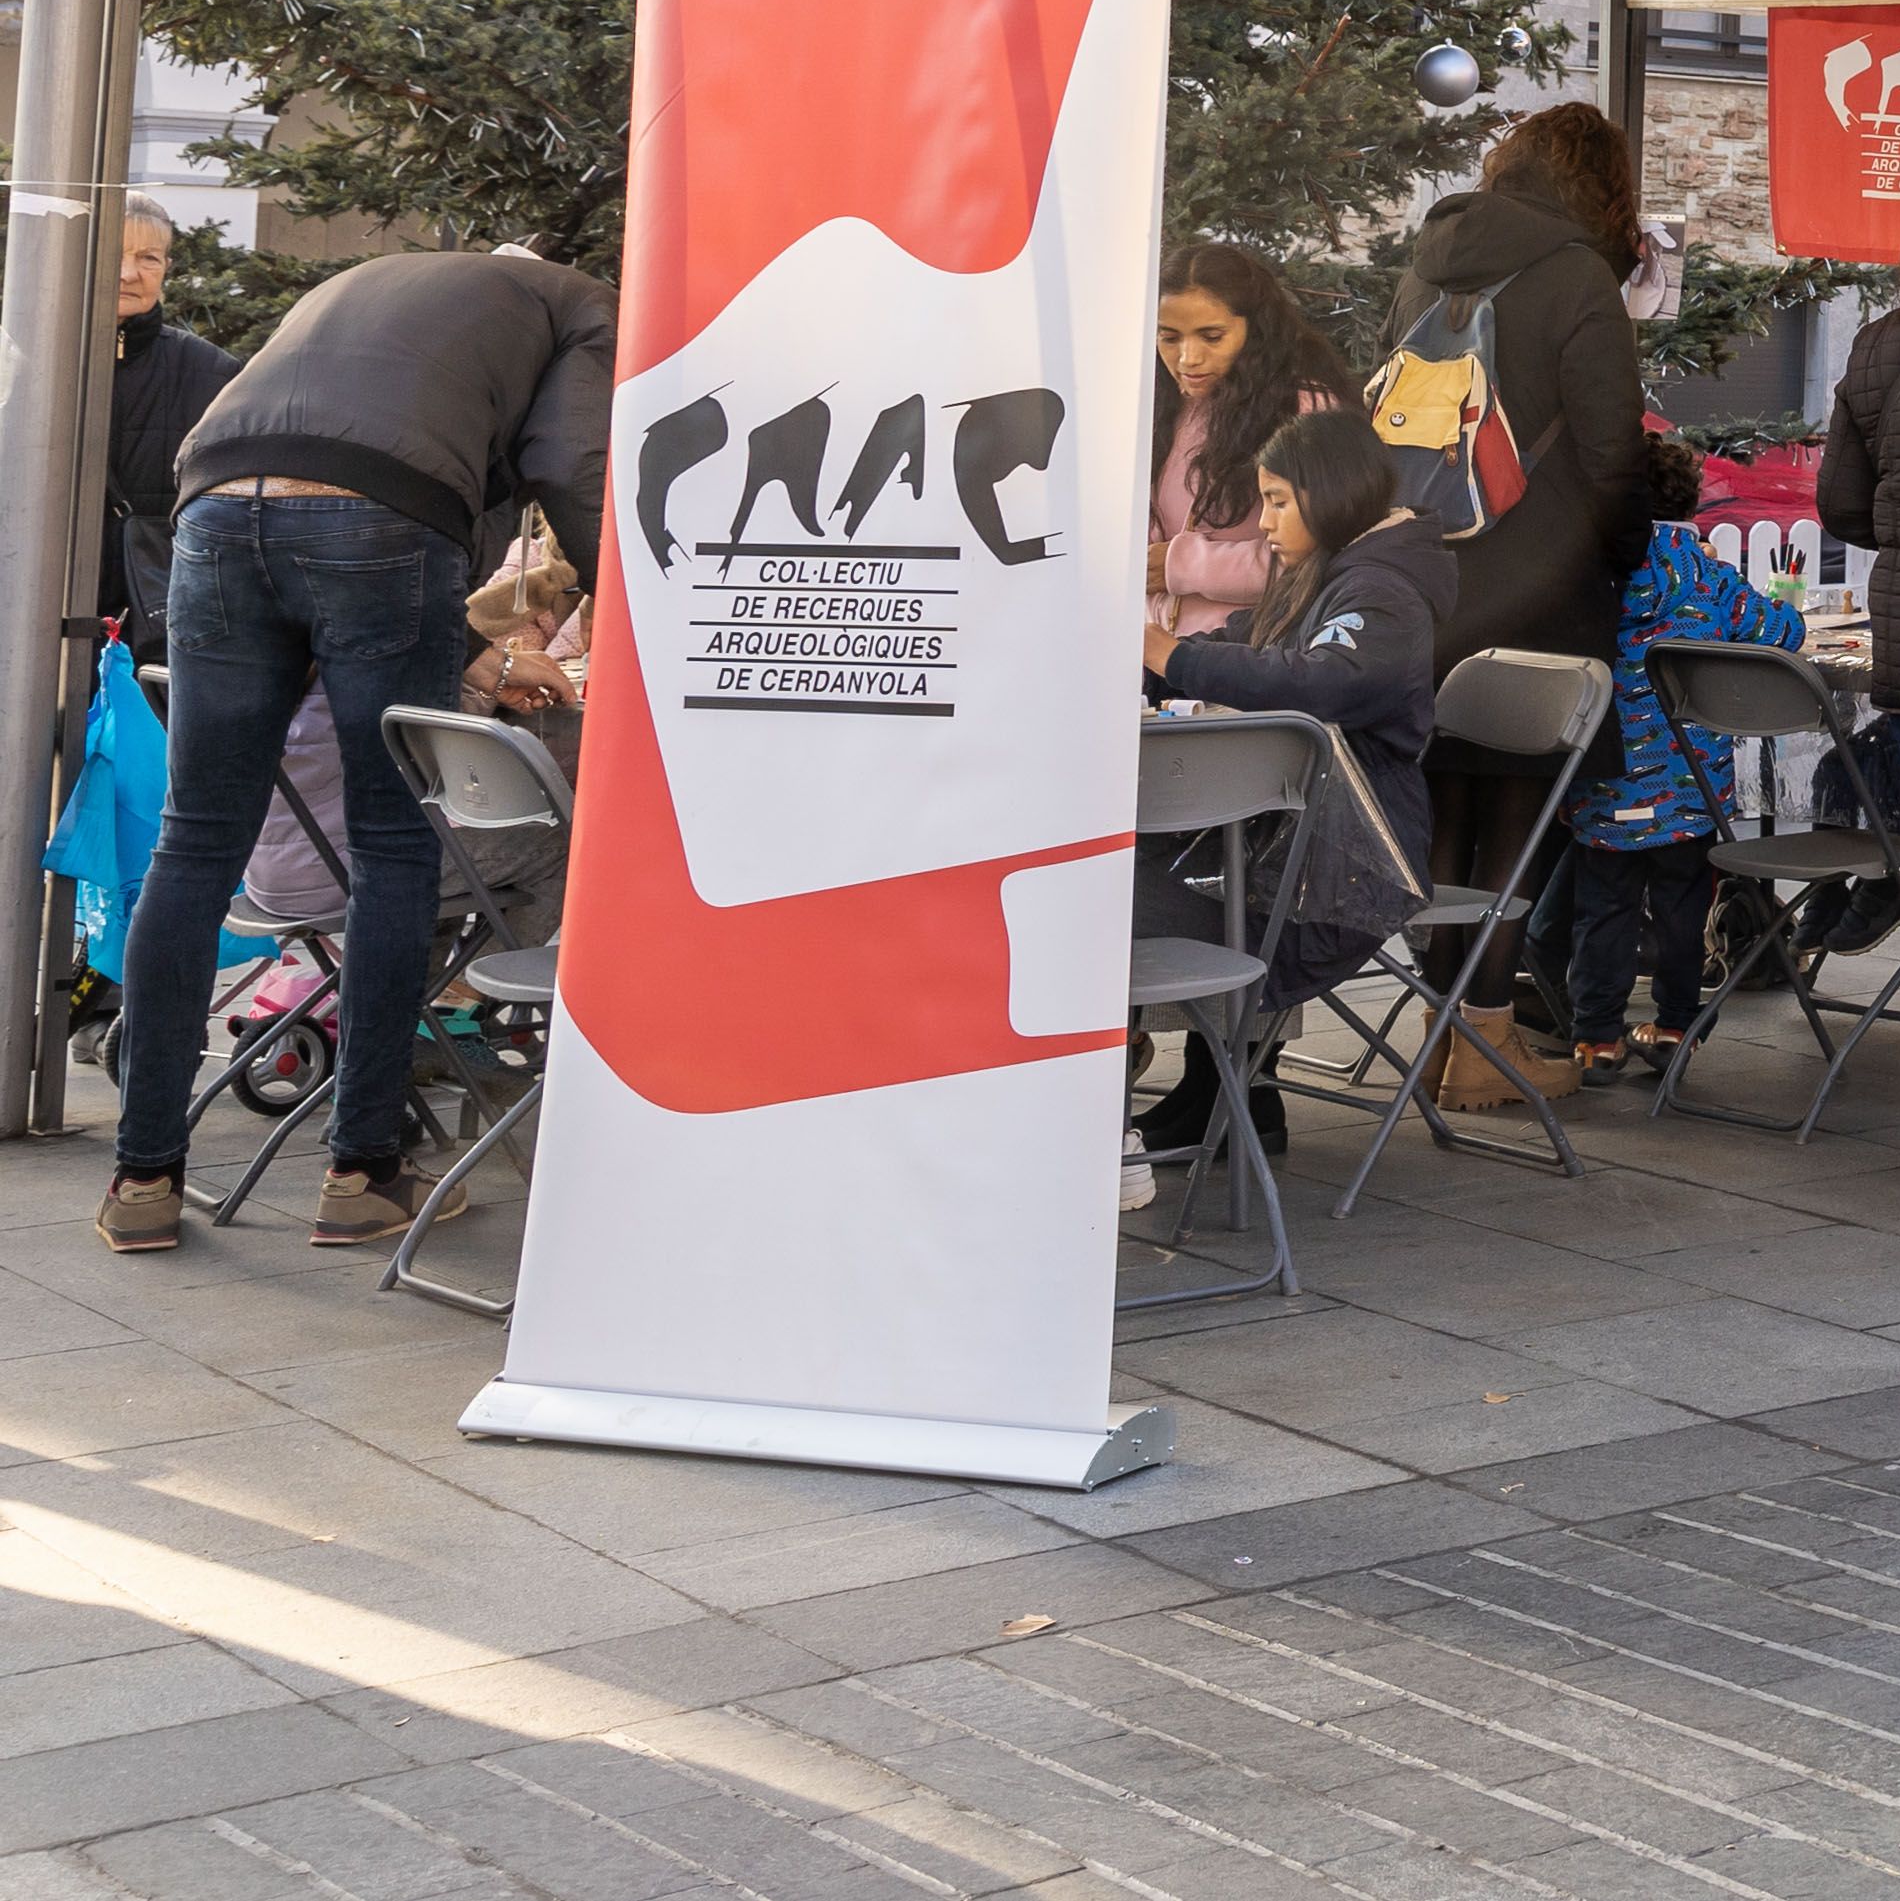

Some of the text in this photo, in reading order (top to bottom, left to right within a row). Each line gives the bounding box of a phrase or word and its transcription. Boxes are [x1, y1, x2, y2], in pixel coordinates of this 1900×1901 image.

[1881, 141, 1900, 155] DE
[1876, 176, 1895, 190] DE
[758, 558, 903, 586] COL·LECTIU
[731, 595, 923, 623] DE RECERQUES
[706, 626, 943, 660] ARQUEOLÒGIQUES
[716, 666, 928, 697] DE CERDANYOLA
